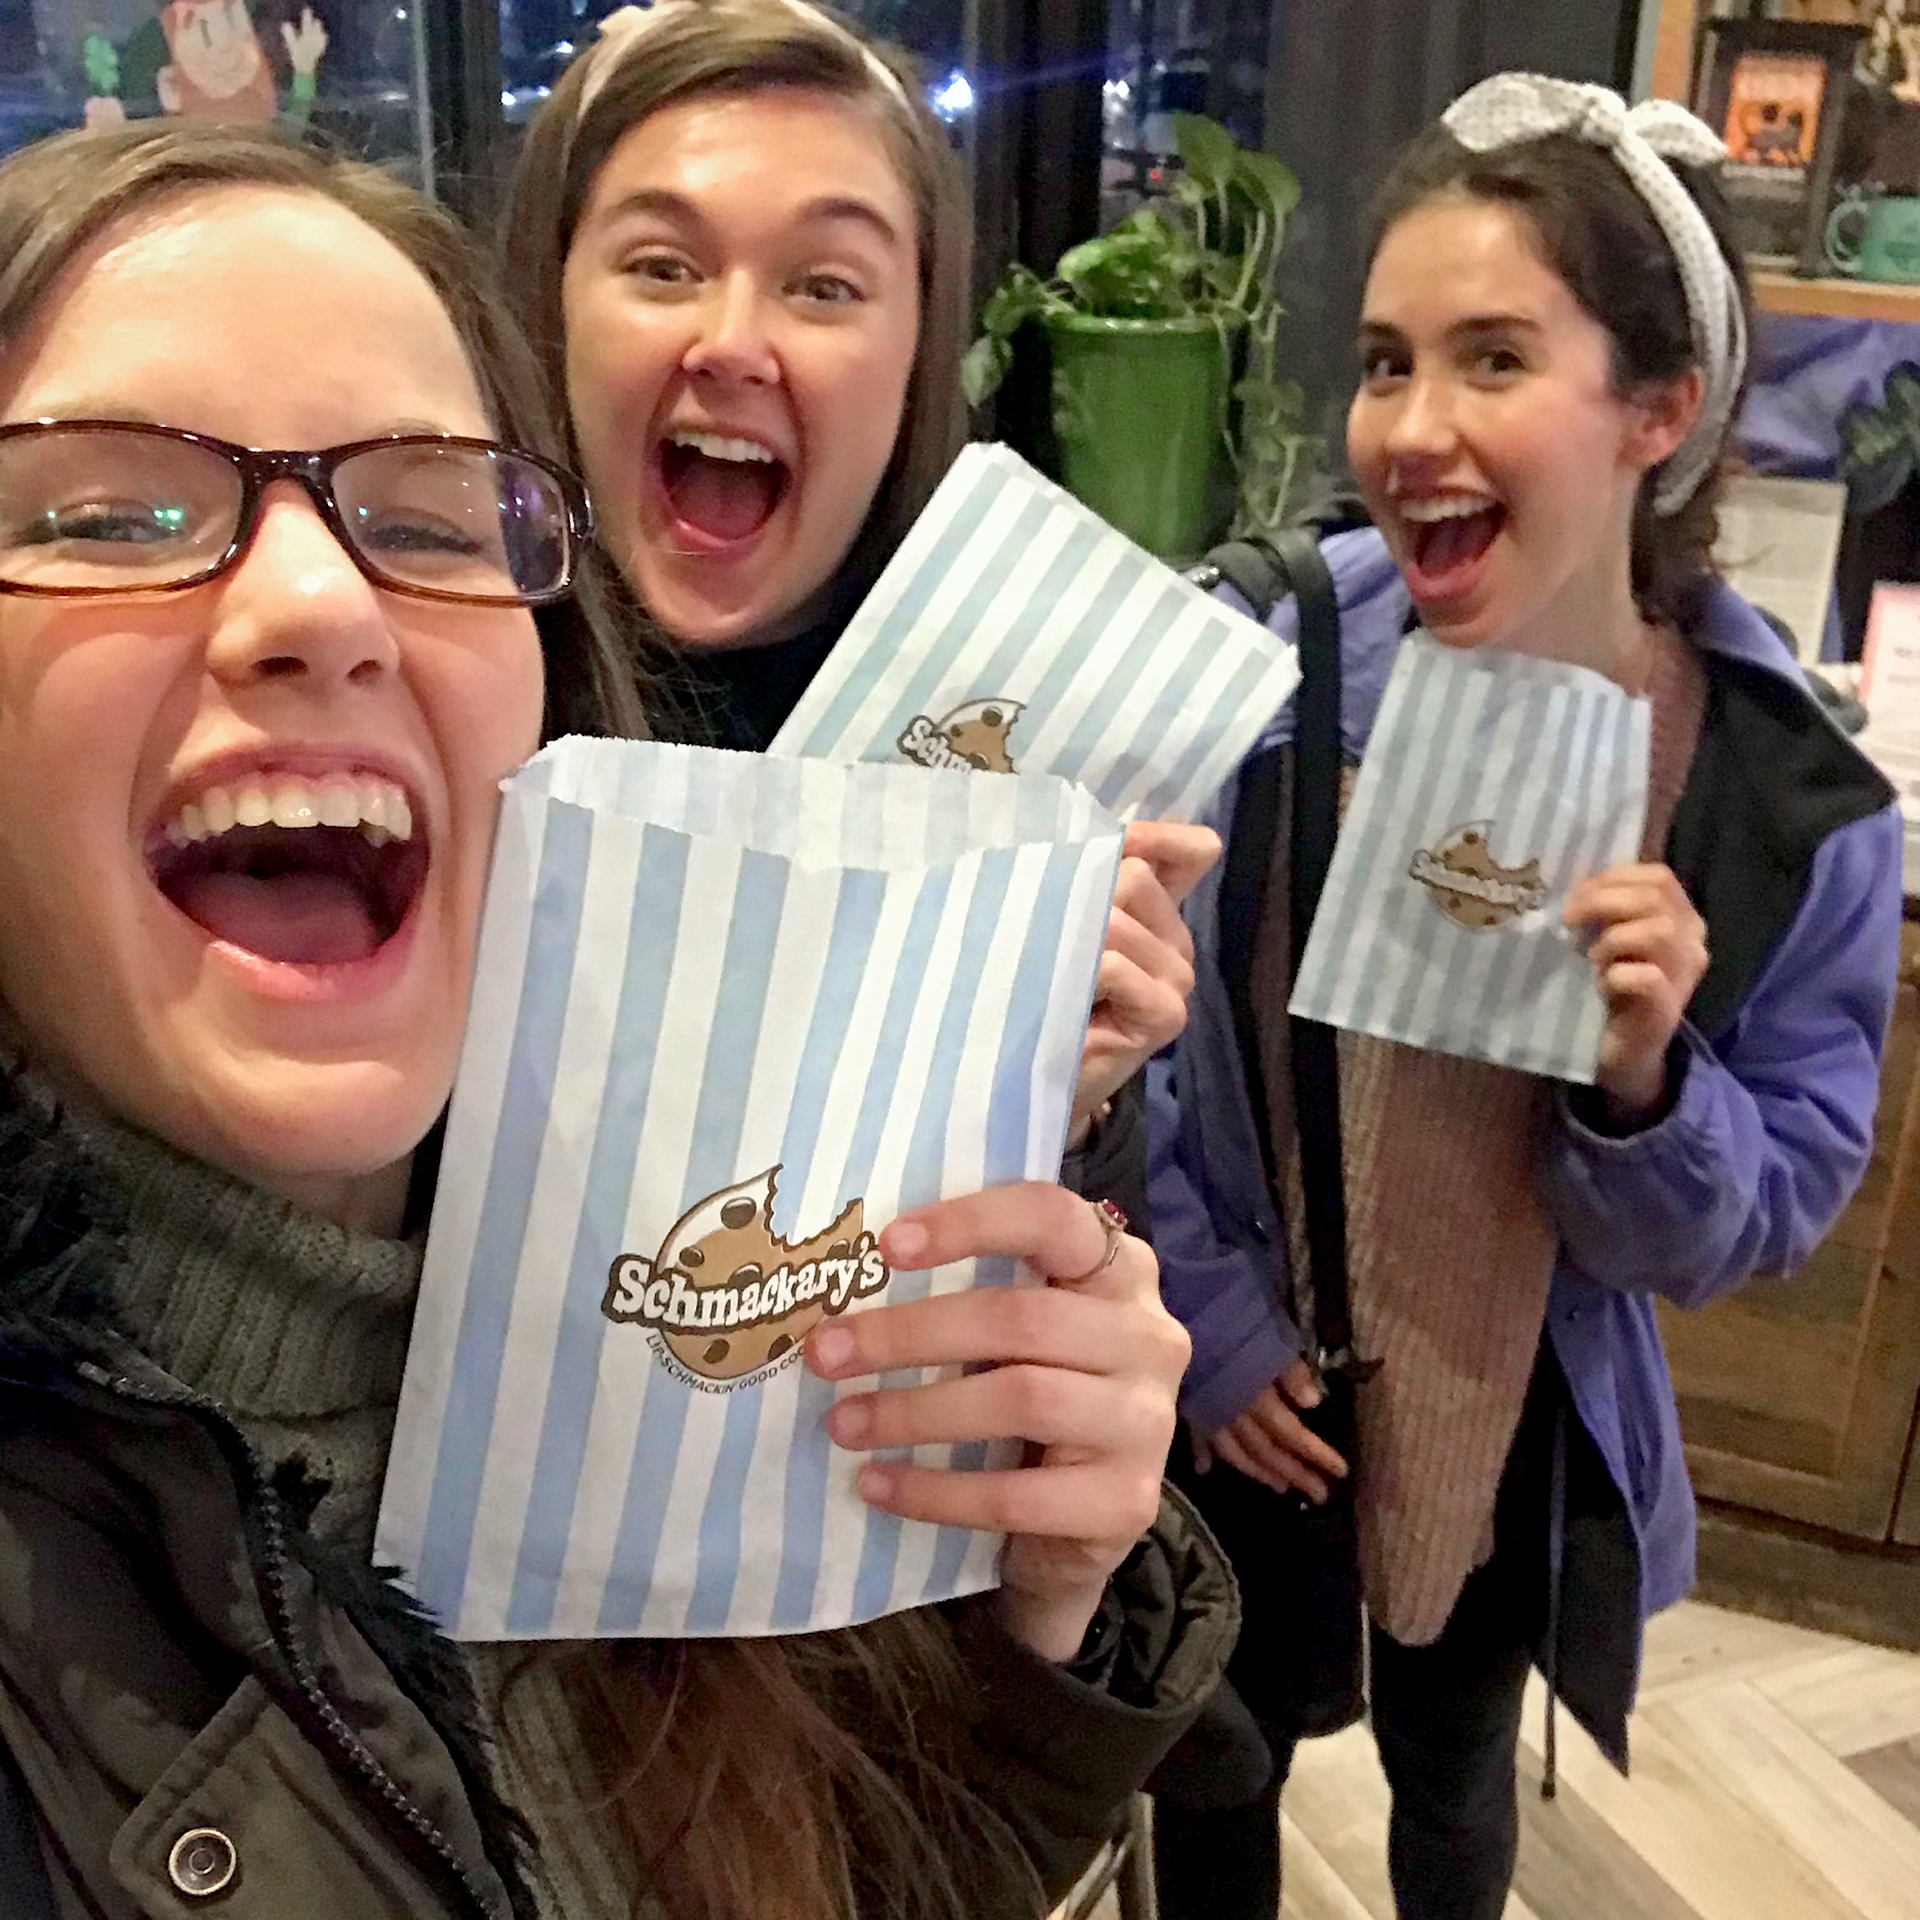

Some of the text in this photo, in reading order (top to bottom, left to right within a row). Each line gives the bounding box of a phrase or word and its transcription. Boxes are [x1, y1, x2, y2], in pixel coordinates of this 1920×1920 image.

[902, 719, 973, 774] Schm
[611, 1235, 884, 1328] Schmackary's
[739, 1366, 778, 1390] GOOD
